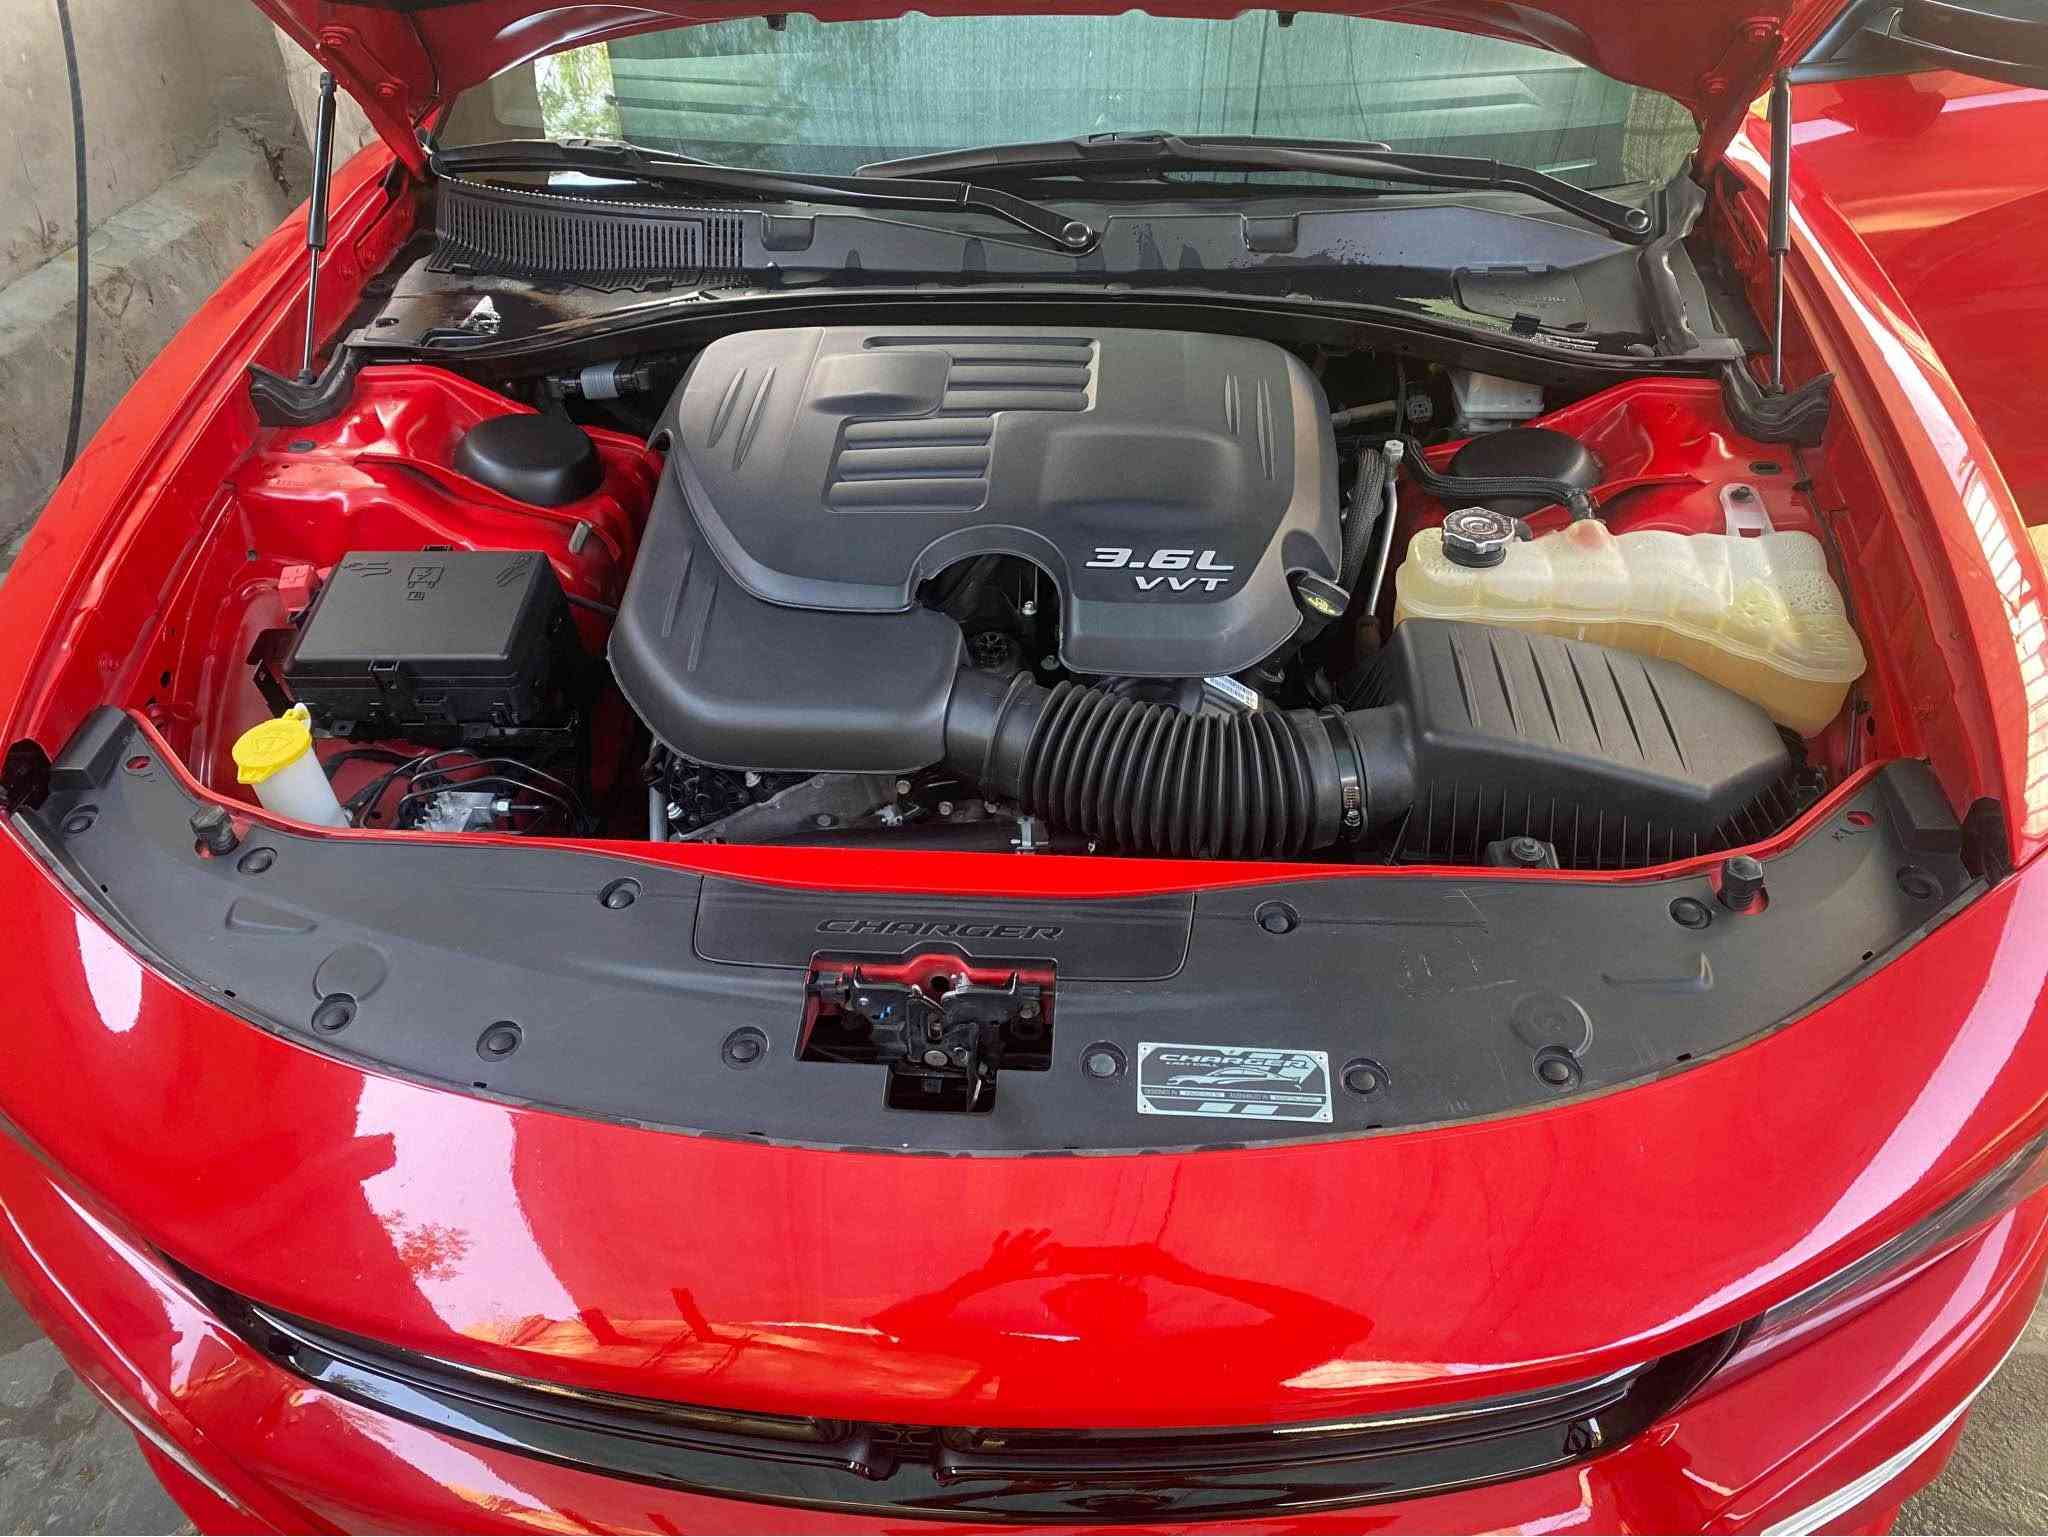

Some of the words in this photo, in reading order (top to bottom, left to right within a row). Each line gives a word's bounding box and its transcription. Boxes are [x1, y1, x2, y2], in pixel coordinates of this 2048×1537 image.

[1085, 547, 1235, 571] 3.6L
[1134, 576, 1229, 592] VVT
[815, 919, 1064, 941] CHARGER
[1159, 1054, 1309, 1070] CHARGER
